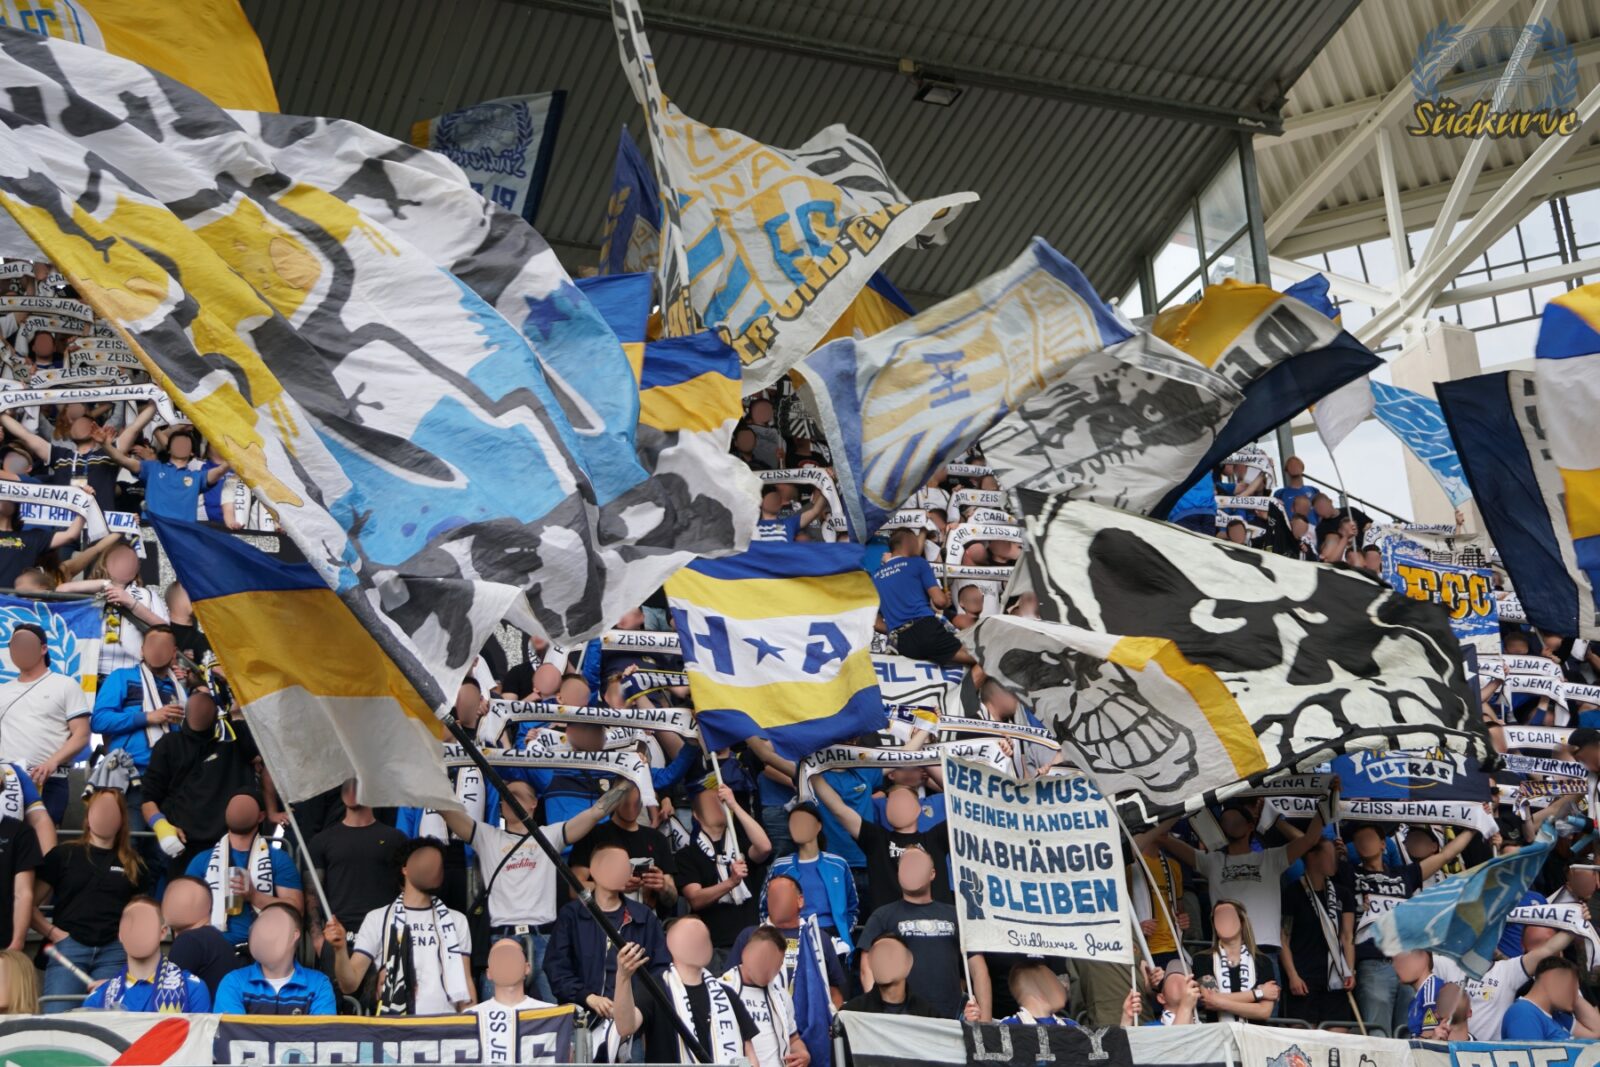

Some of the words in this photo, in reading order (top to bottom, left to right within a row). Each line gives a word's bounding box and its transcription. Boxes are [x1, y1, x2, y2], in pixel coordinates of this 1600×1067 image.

[20, 297, 53, 308] ZEISS
[55, 300, 84, 315] JENA
[60, 365, 97, 379] ZEISS
[3, 390, 43, 405] CARL
[793, 470, 822, 483] JENA
[33, 487, 69, 503] JENA
[1229, 496, 1255, 506] ZEISS
[983, 512, 1007, 523] CARL
[982, 526, 1011, 537] ZEISS
[1398, 563, 1492, 620] FCC
[617, 633, 657, 647] ZEISS
[670, 606, 737, 677] H
[801, 621, 853, 675] A
[1509, 658, 1540, 671] JENA
[1522, 677, 1553, 691] JENA
[511, 701, 555, 715] CARL
[575, 705, 622, 719] ZEISS
[625, 708, 668, 723] JENA
[1509, 731, 1525, 743] FC
[1528, 732, 1559, 745] CARL
[502, 747, 556, 760] ZEISS
[560, 749, 611, 764] JENA
[614, 752, 629, 767] E.
[816, 748, 857, 762] CARL
[1368, 761, 1451, 781] ULTRAS
[946, 758, 982, 797] DER
[987, 774, 1030, 805] FCC
[5, 775, 20, 812] CARL
[1273, 798, 1290, 811] FC
[1350, 801, 1393, 815] ZEISS
[1397, 803, 1437, 817] JENA
[1442, 804, 1455, 818] E.
[1460, 807, 1472, 821] V.
[965, 799, 1020, 831] SEINEM
[1023, 809, 1109, 833] HANDELN
[954, 828, 1114, 874] UNABHÄNGIG
[987, 874, 1119, 915] BLEIBEN
[1084, 932, 1123, 956] Jena
